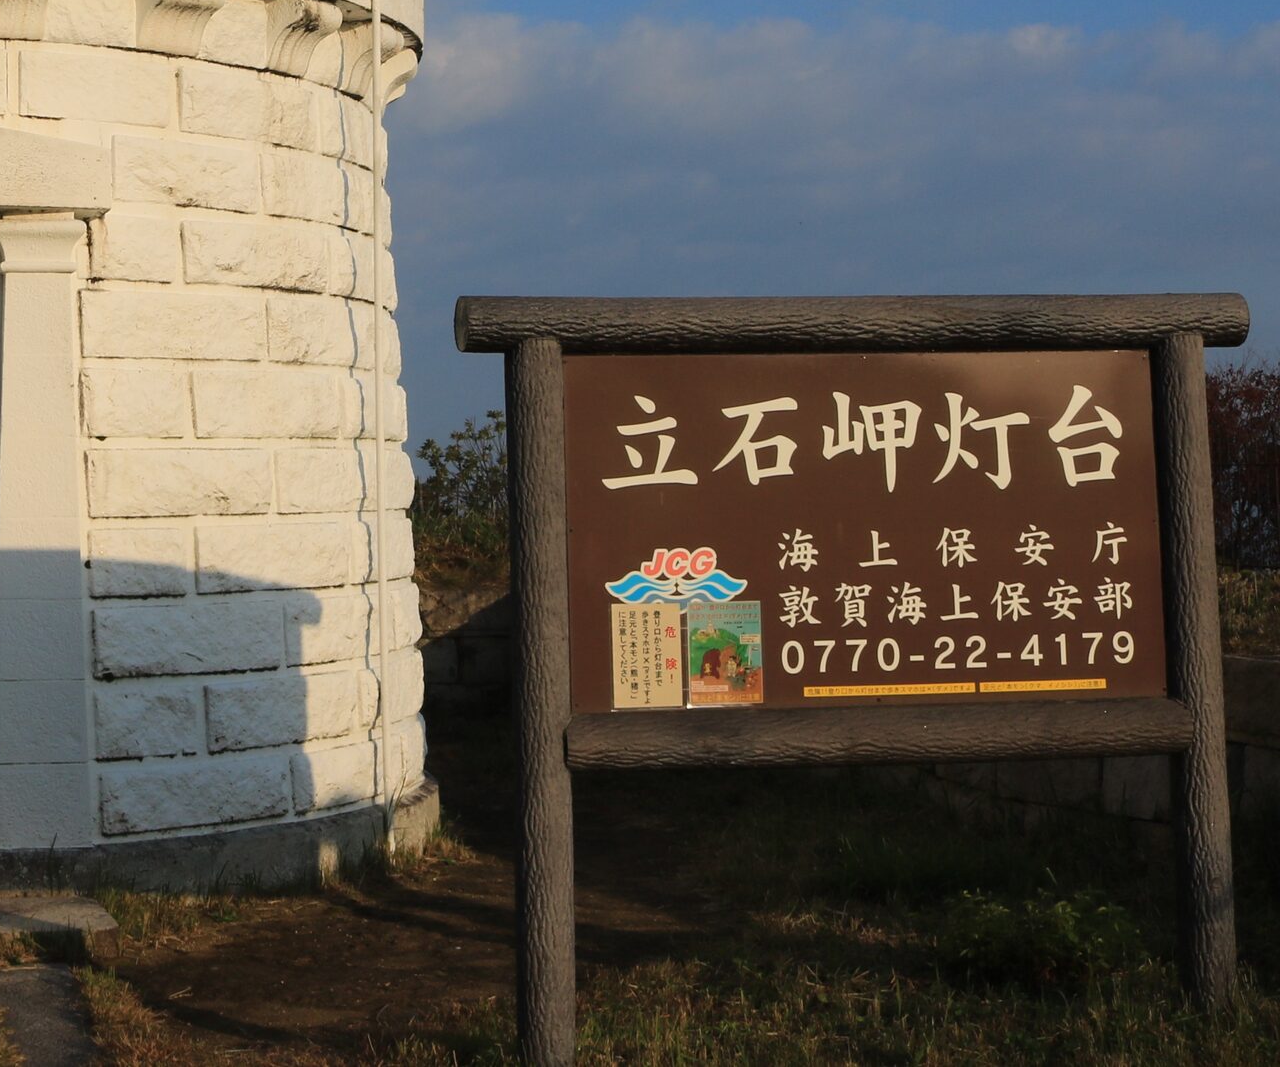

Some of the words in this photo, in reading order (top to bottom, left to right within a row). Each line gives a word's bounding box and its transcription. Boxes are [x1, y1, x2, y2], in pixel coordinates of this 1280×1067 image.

[601, 384, 1124, 493] 立石岬灯台
[643, 549, 715, 577] JCG
[777, 521, 1129, 573] 海上保安庁
[779, 577, 1134, 629] 敦賀海上保安部
[653, 609, 663, 687] 登り口から灯台まで
[781, 631, 1136, 675] 0770-22-4179
